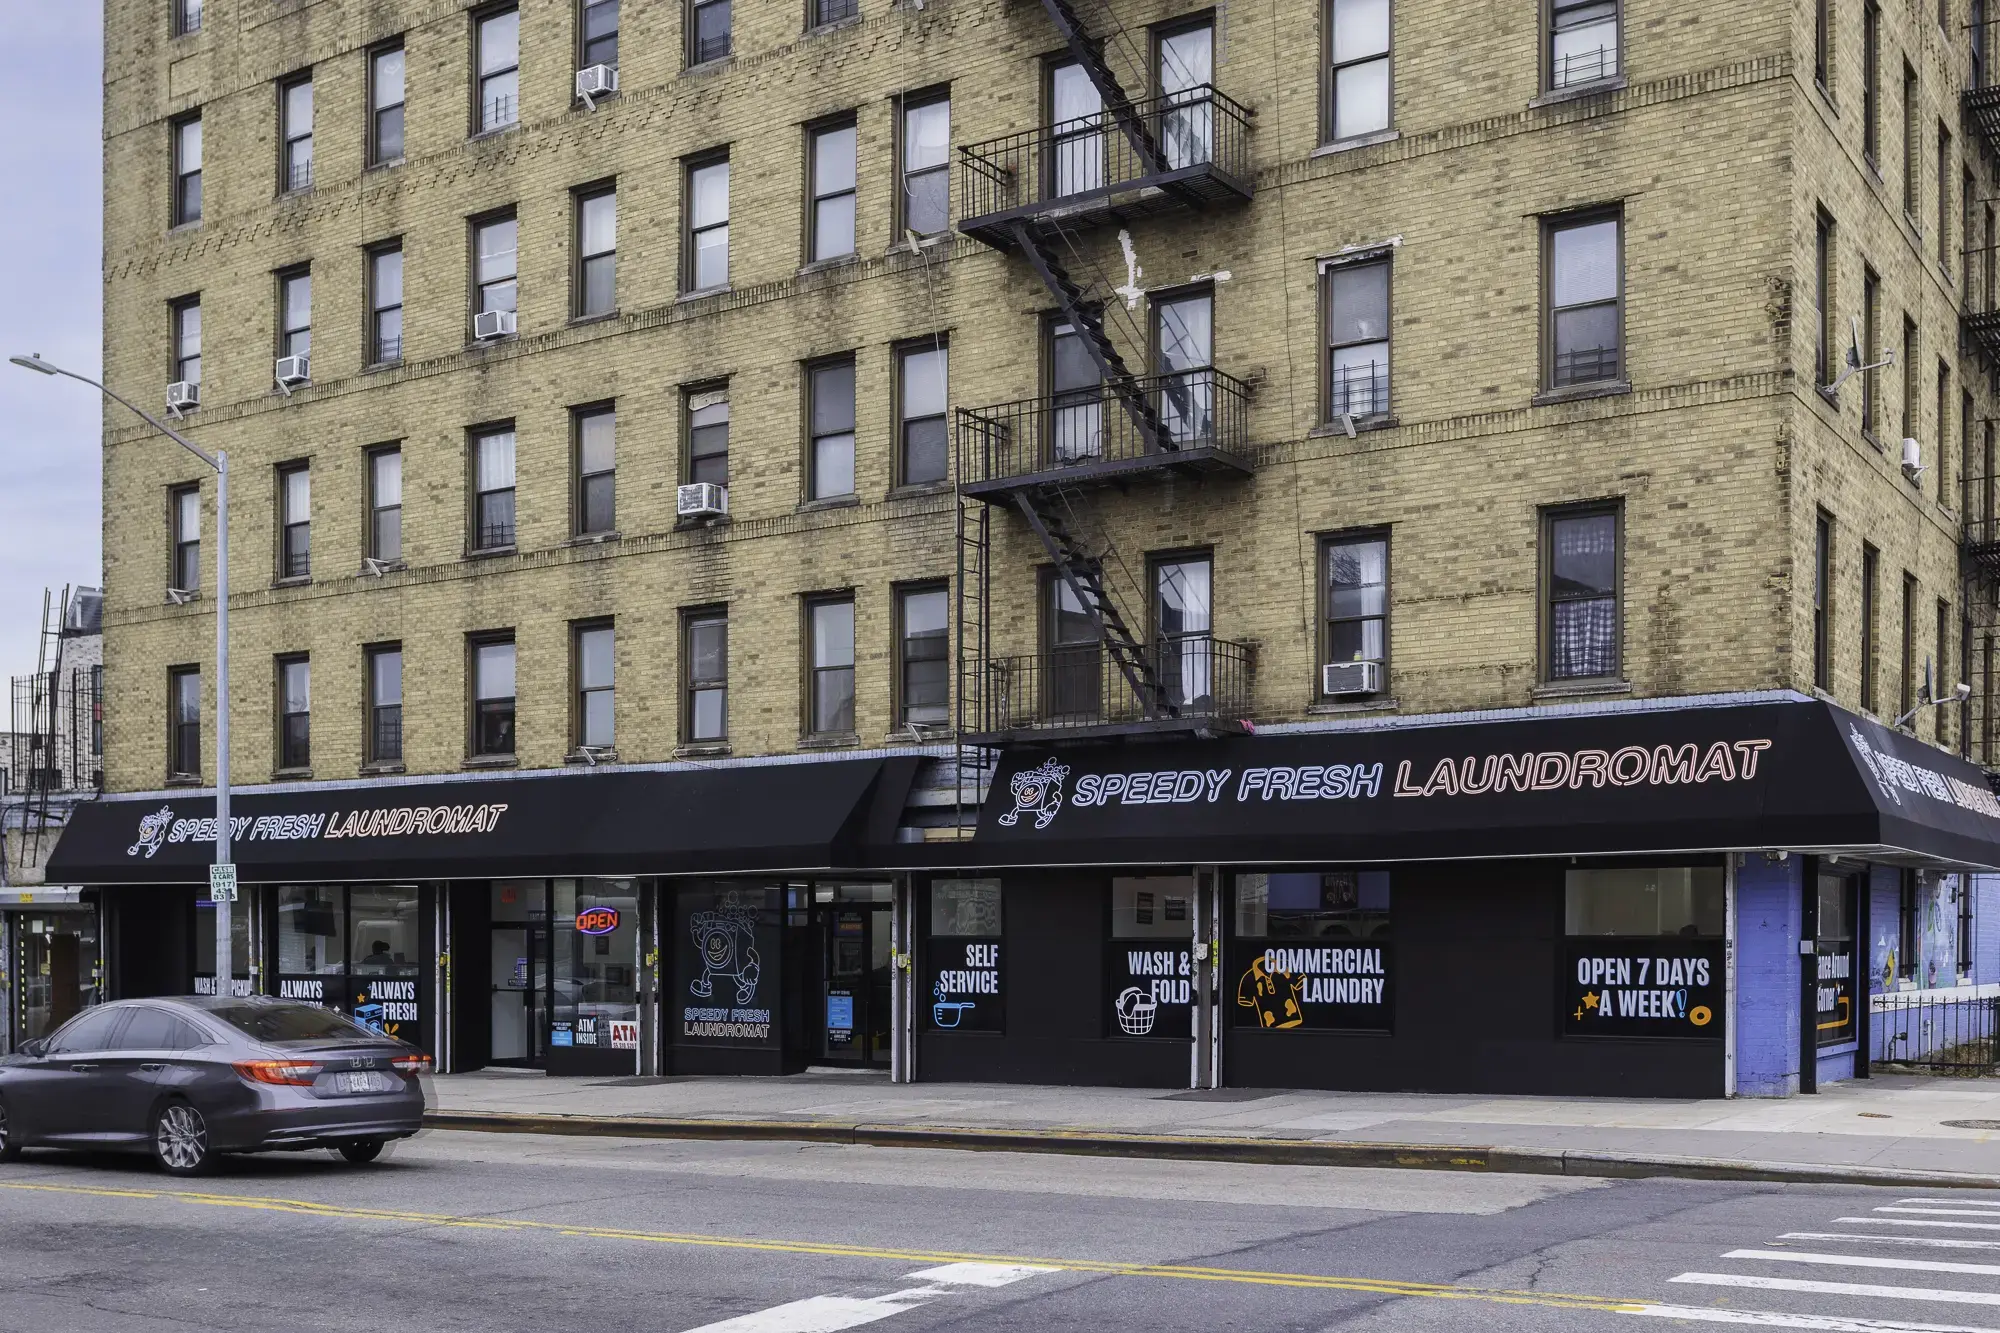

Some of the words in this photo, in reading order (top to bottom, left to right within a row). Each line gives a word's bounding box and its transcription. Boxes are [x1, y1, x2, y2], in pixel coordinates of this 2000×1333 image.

[1072, 768, 1231, 807] SPEEDY
[1237, 762, 1383, 802] FRESH
[1394, 739, 1771, 796] LAUNDROMAT
[1874, 750, 1920, 793] SPEEDY
[1912, 764, 1954, 804] FRESH
[250, 813, 326, 841] FRESH
[324, 804, 508, 838] LAUNDROMAT
[212, 866, 234, 874] CASH
[576, 912, 618, 930] OPEN
[966, 944, 998, 967] SELF
[1128, 951, 1174, 976] WASH
[1179, 951, 1190, 976] &
[1264, 948, 1384, 974] COMMERCIAL
[940, 970, 998, 994] SERVICE
[1577, 957, 1631, 985] OPEN
[1637, 958, 1650, 985] 7
[1656, 958, 1710, 986] DAYS
[195, 977, 210, 994] WASH
[280, 980, 323, 998] ALWAYS
[370, 981, 415, 1000] ALWAYS
[1152, 979, 1190, 1004] FOLD
[1302, 978, 1384, 1003] LAUNDRY
[383, 1002, 417, 1021] FRESH
[684, 1007, 729, 1022] SPEEDY
[731, 1008, 770, 1022] FRESH
[1599, 990, 1612, 1016] A
[578, 1019, 594, 1032] ATM
[684, 1022, 770, 1038] LAUNDROMAT
[576, 1033, 597, 1045] INSIDE
